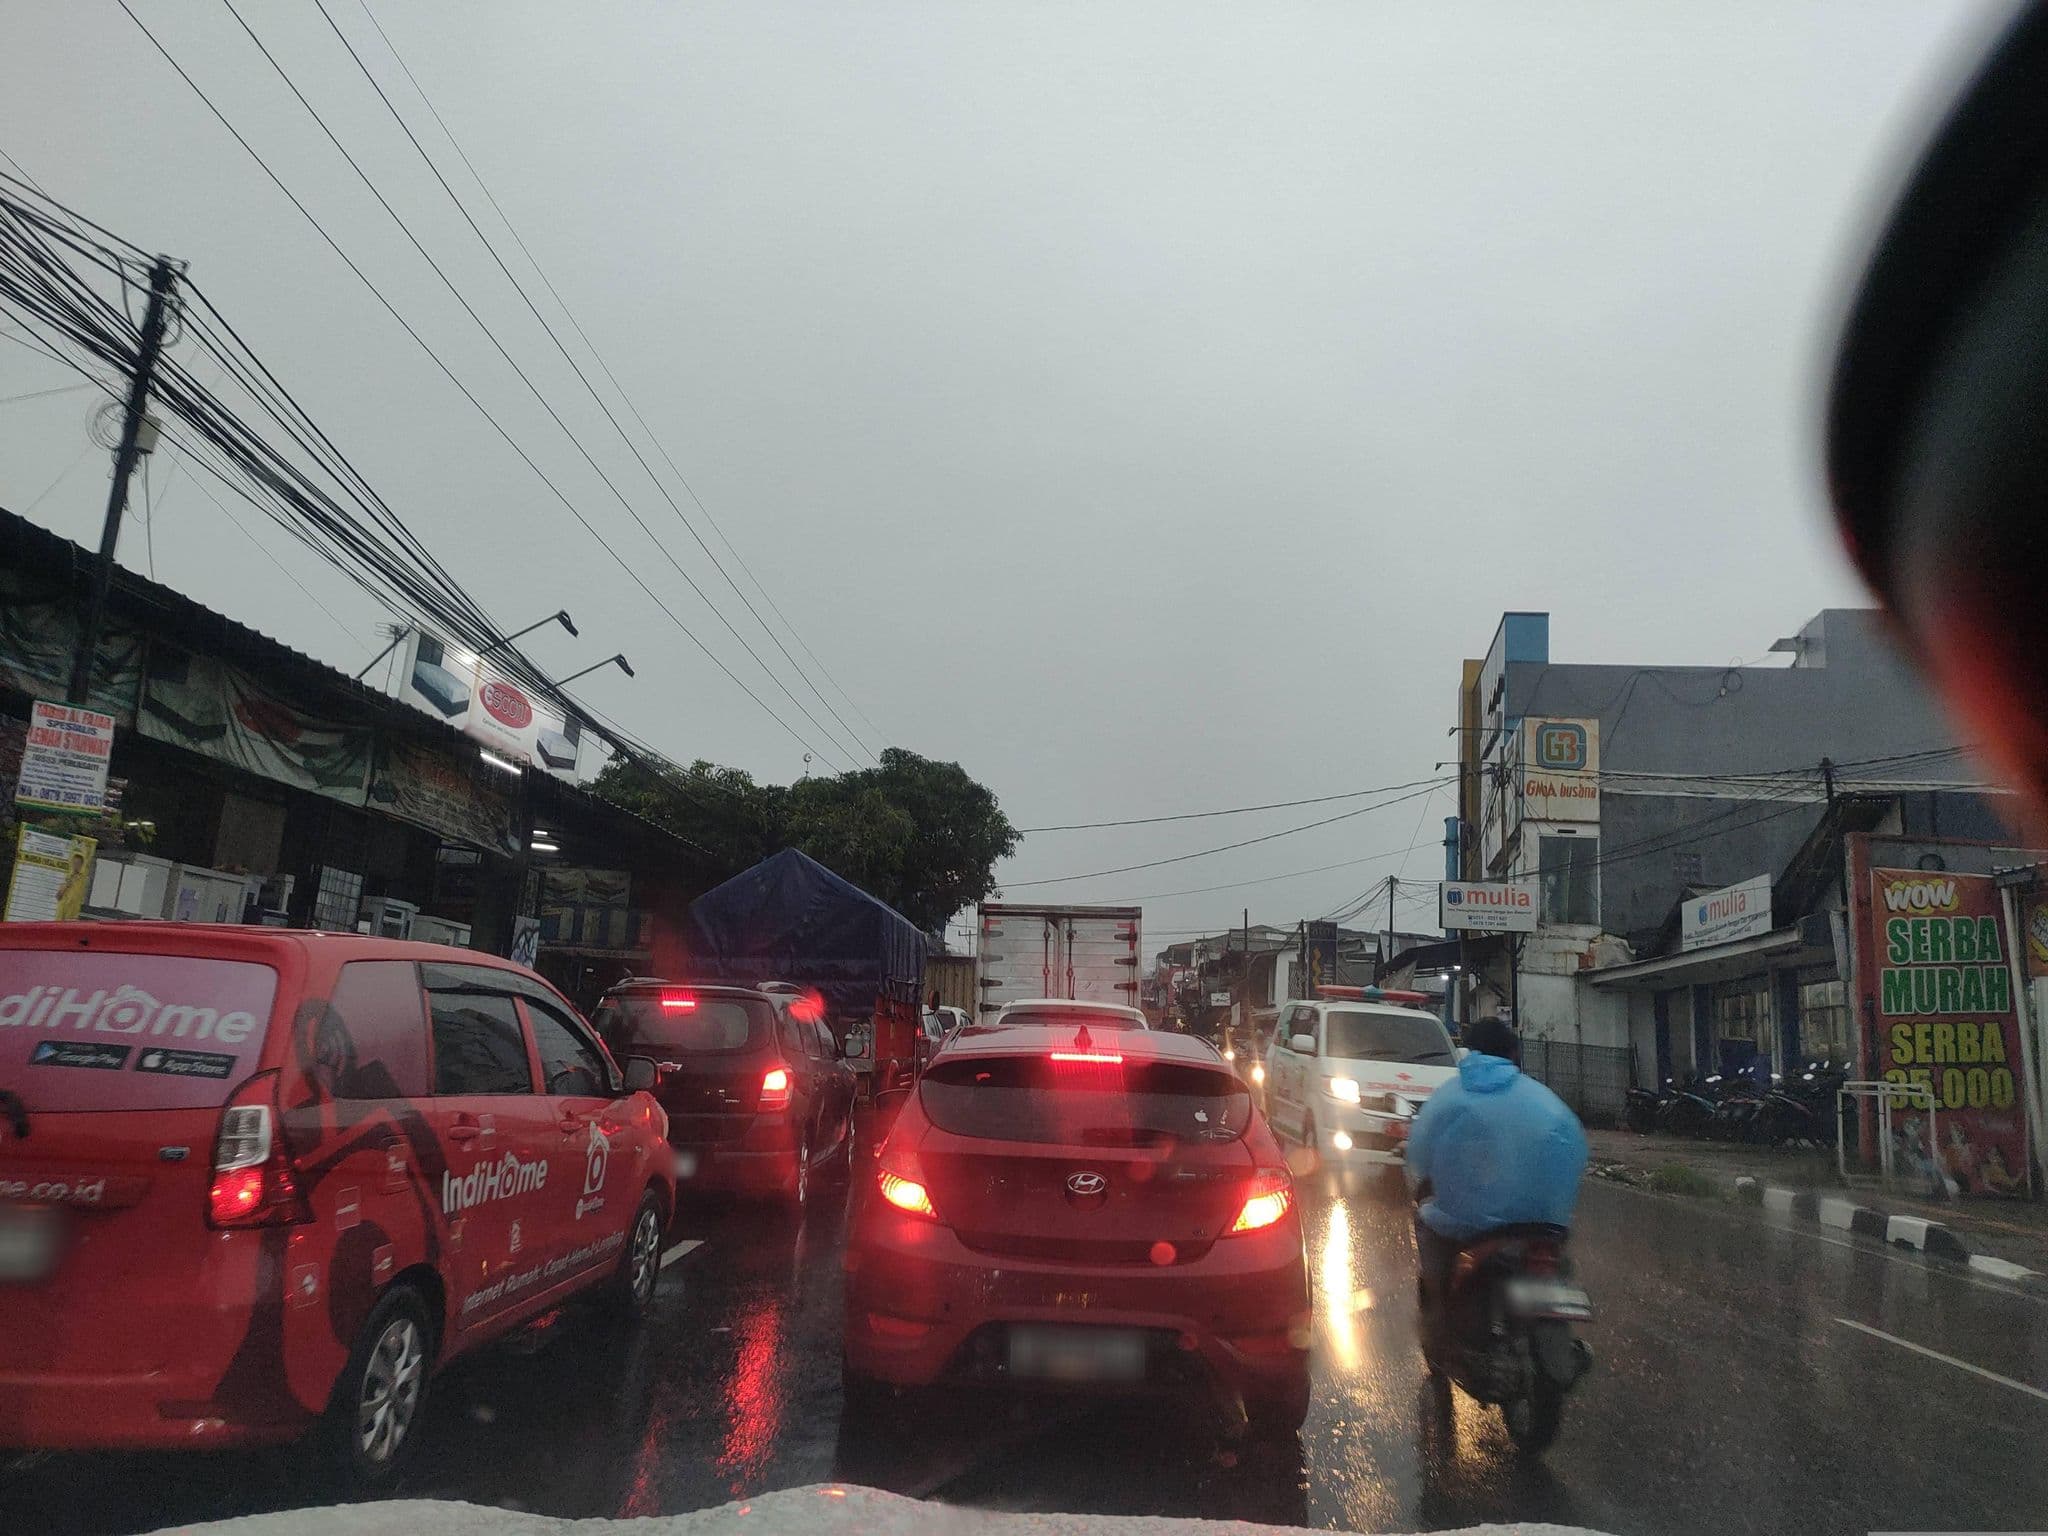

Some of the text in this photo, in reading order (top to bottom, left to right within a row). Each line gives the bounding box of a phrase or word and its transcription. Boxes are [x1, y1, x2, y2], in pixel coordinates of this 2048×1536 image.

[1560, 783, 1597, 799] busana
[1467, 887, 1530, 907] mulia
[1709, 889, 1746, 921] mulia
[1883, 881, 1956, 912] WOW
[1886, 915, 2003, 965] SERBA
[1881, 966, 2011, 1015] MURAH
[1890, 1022, 2006, 1065] SERBA
[1884, 1067, 2014, 1110] 35.000
[442, 1151, 549, 1215] IndiHome
